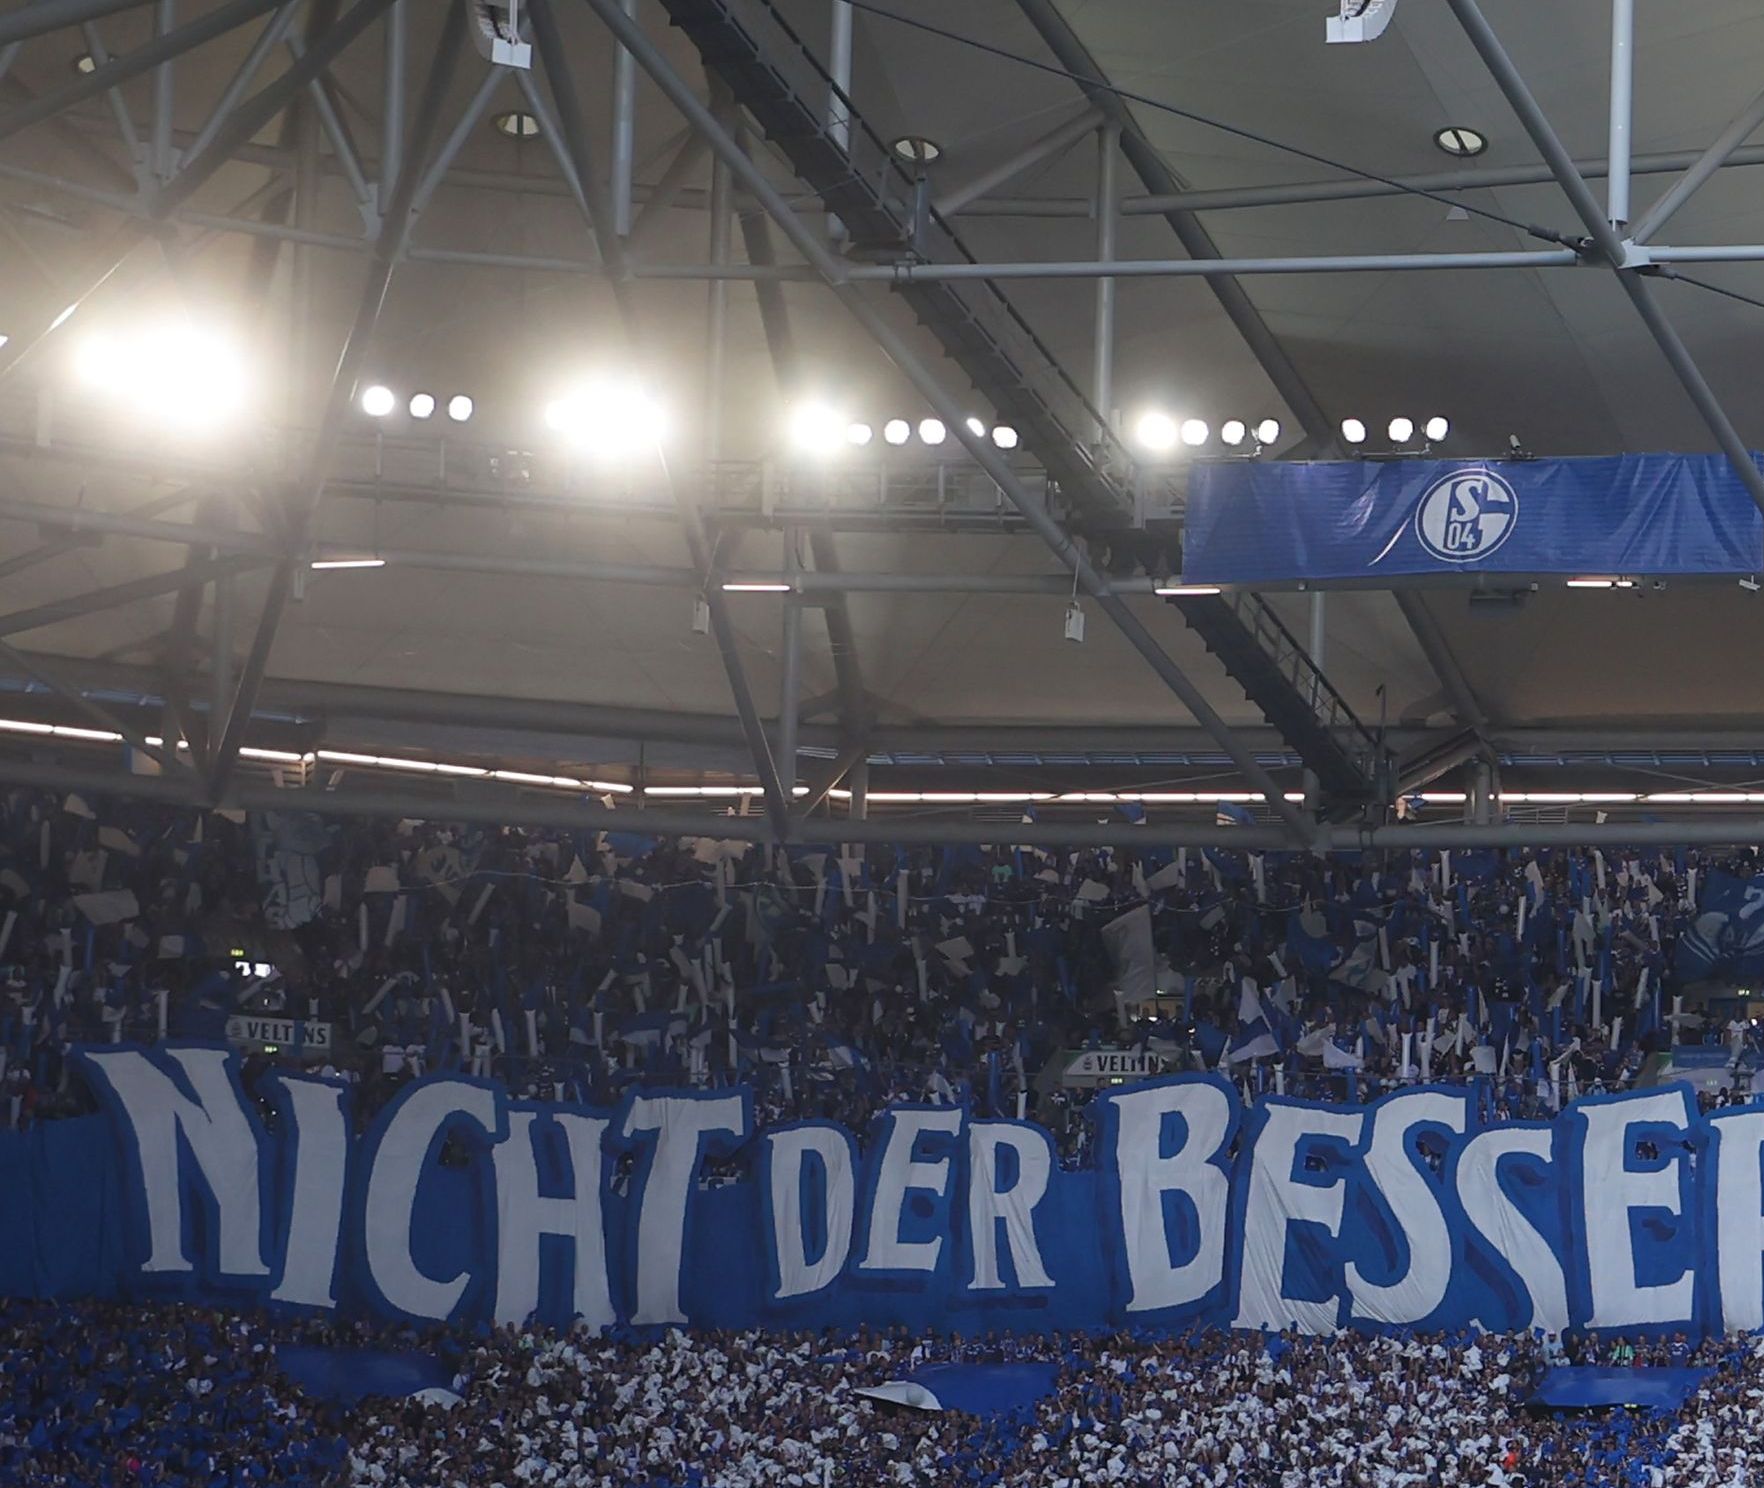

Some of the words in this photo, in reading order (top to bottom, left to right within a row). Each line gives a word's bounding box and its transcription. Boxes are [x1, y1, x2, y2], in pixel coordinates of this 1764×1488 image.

[247, 1022, 327, 1045] VELTNS
[1097, 1055, 1165, 1072] VELTIN
[87, 1048, 744, 1324] NICHT
[766, 1108, 1056, 1298] DER
